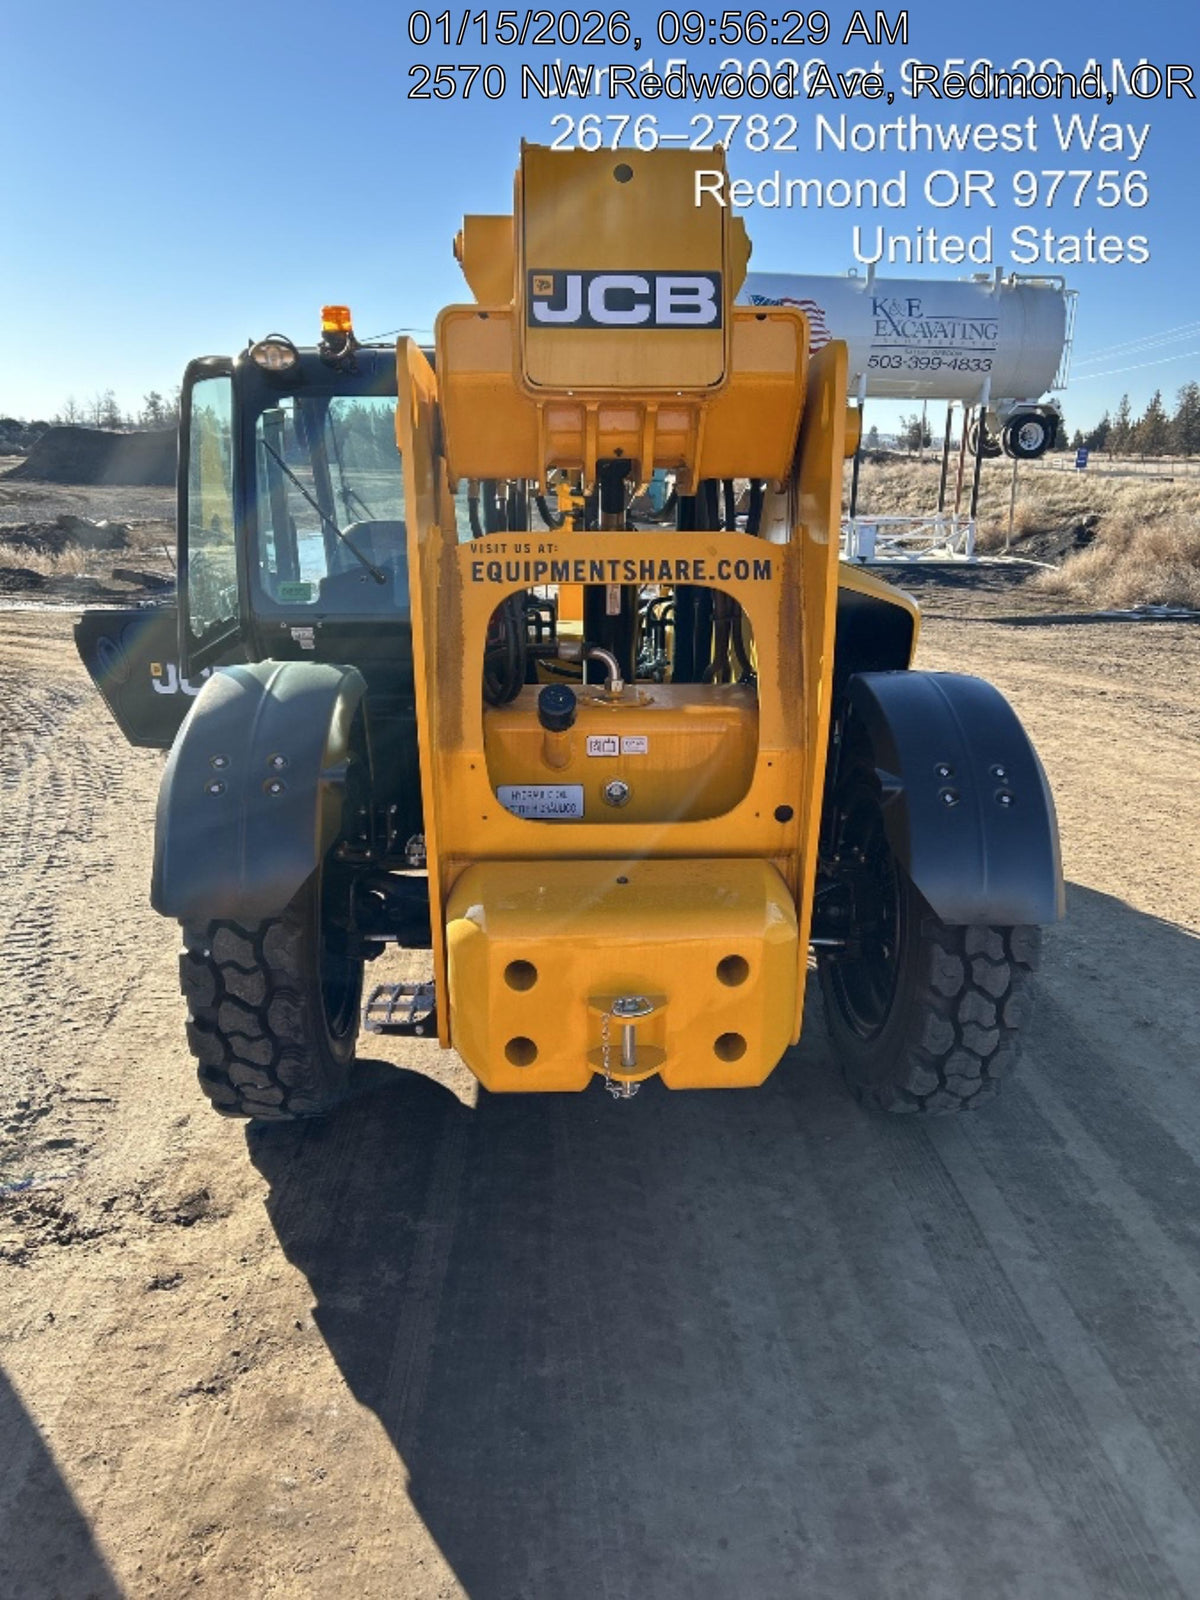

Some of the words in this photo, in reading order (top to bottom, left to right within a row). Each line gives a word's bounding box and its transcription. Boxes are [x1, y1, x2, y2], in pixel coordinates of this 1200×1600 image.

[532, 275, 718, 324] JCB
[870, 297, 924, 319] K&E
[873, 319, 999, 341] EXCAVATING
[867, 354, 993, 373] 503-399-4833
[470, 542, 508, 554] VISIT
[514, 543, 531, 554] US
[470, 558, 772, 583] EQUIPMENTSHARE.COM
